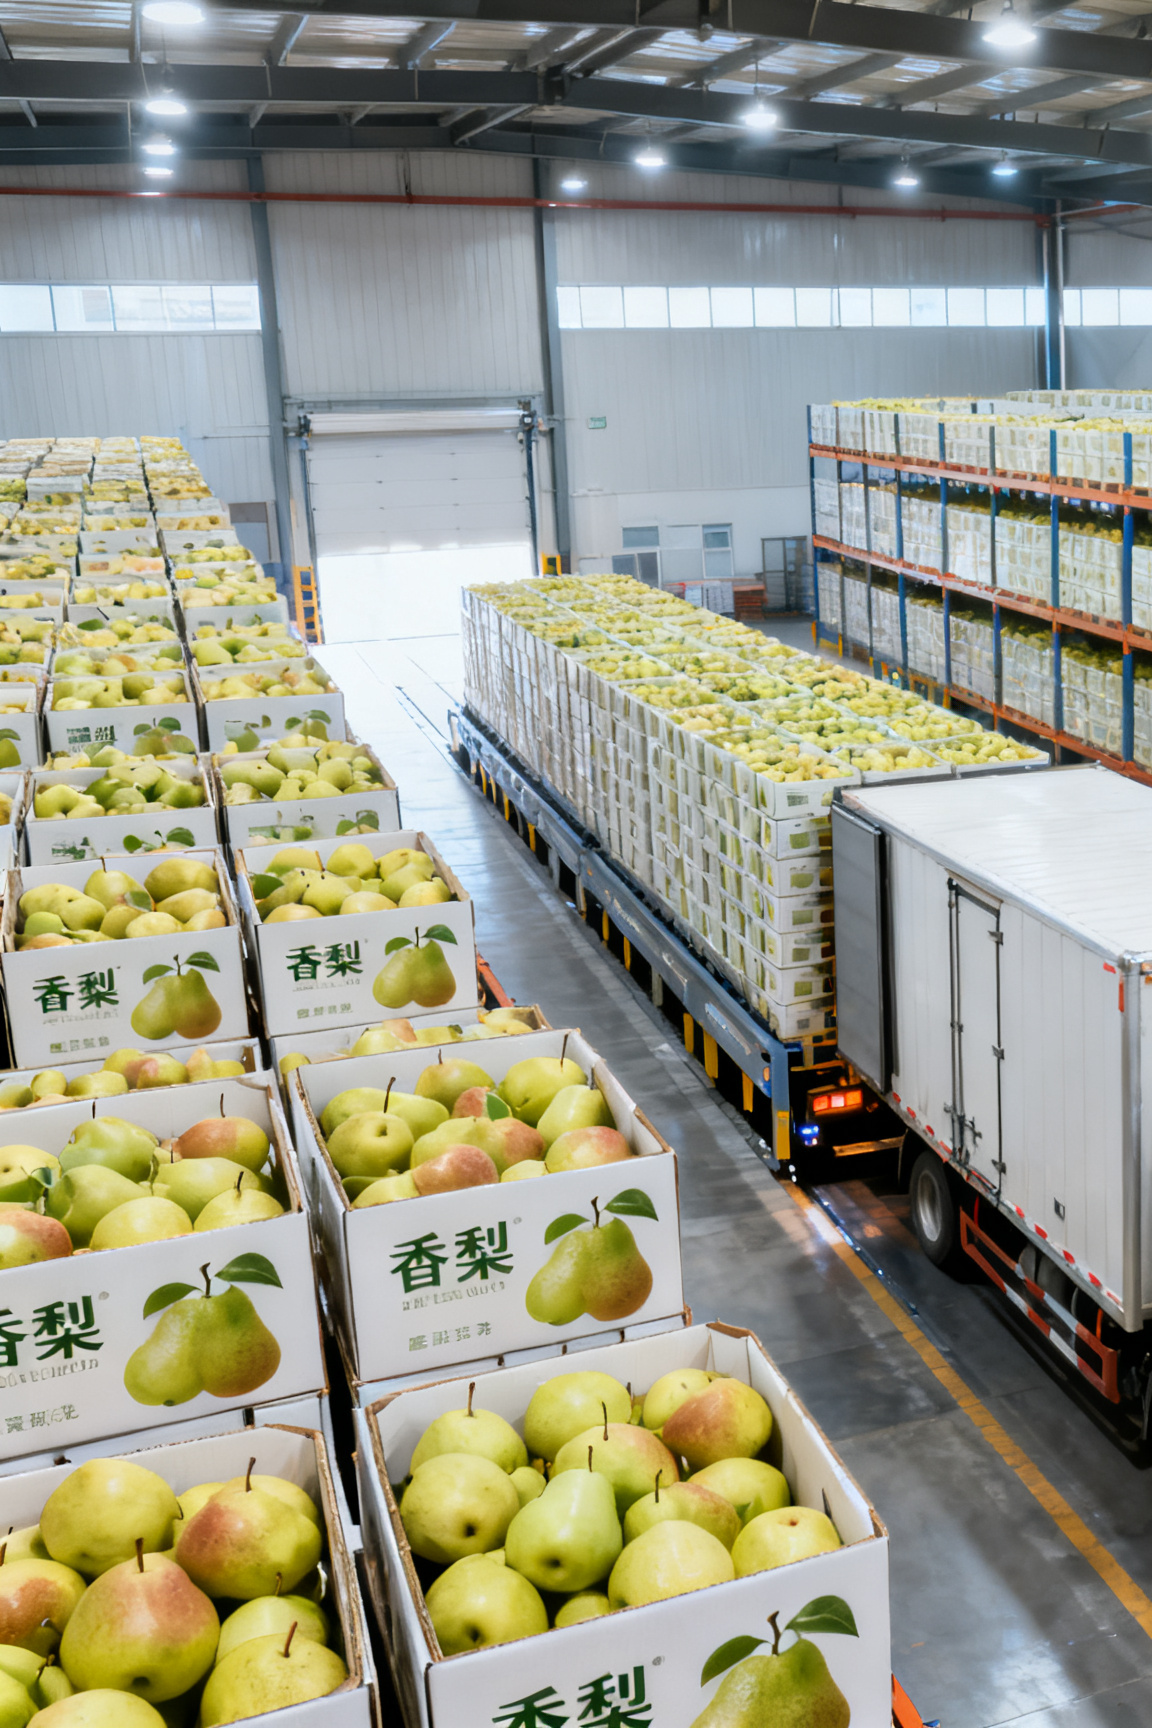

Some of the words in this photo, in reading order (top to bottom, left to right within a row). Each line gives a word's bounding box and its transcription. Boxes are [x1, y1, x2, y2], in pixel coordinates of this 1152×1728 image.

[285, 940, 363, 982] 香梨
[33, 967, 119, 1014] 香梨
[389, 1221, 514, 1294] 香梨
